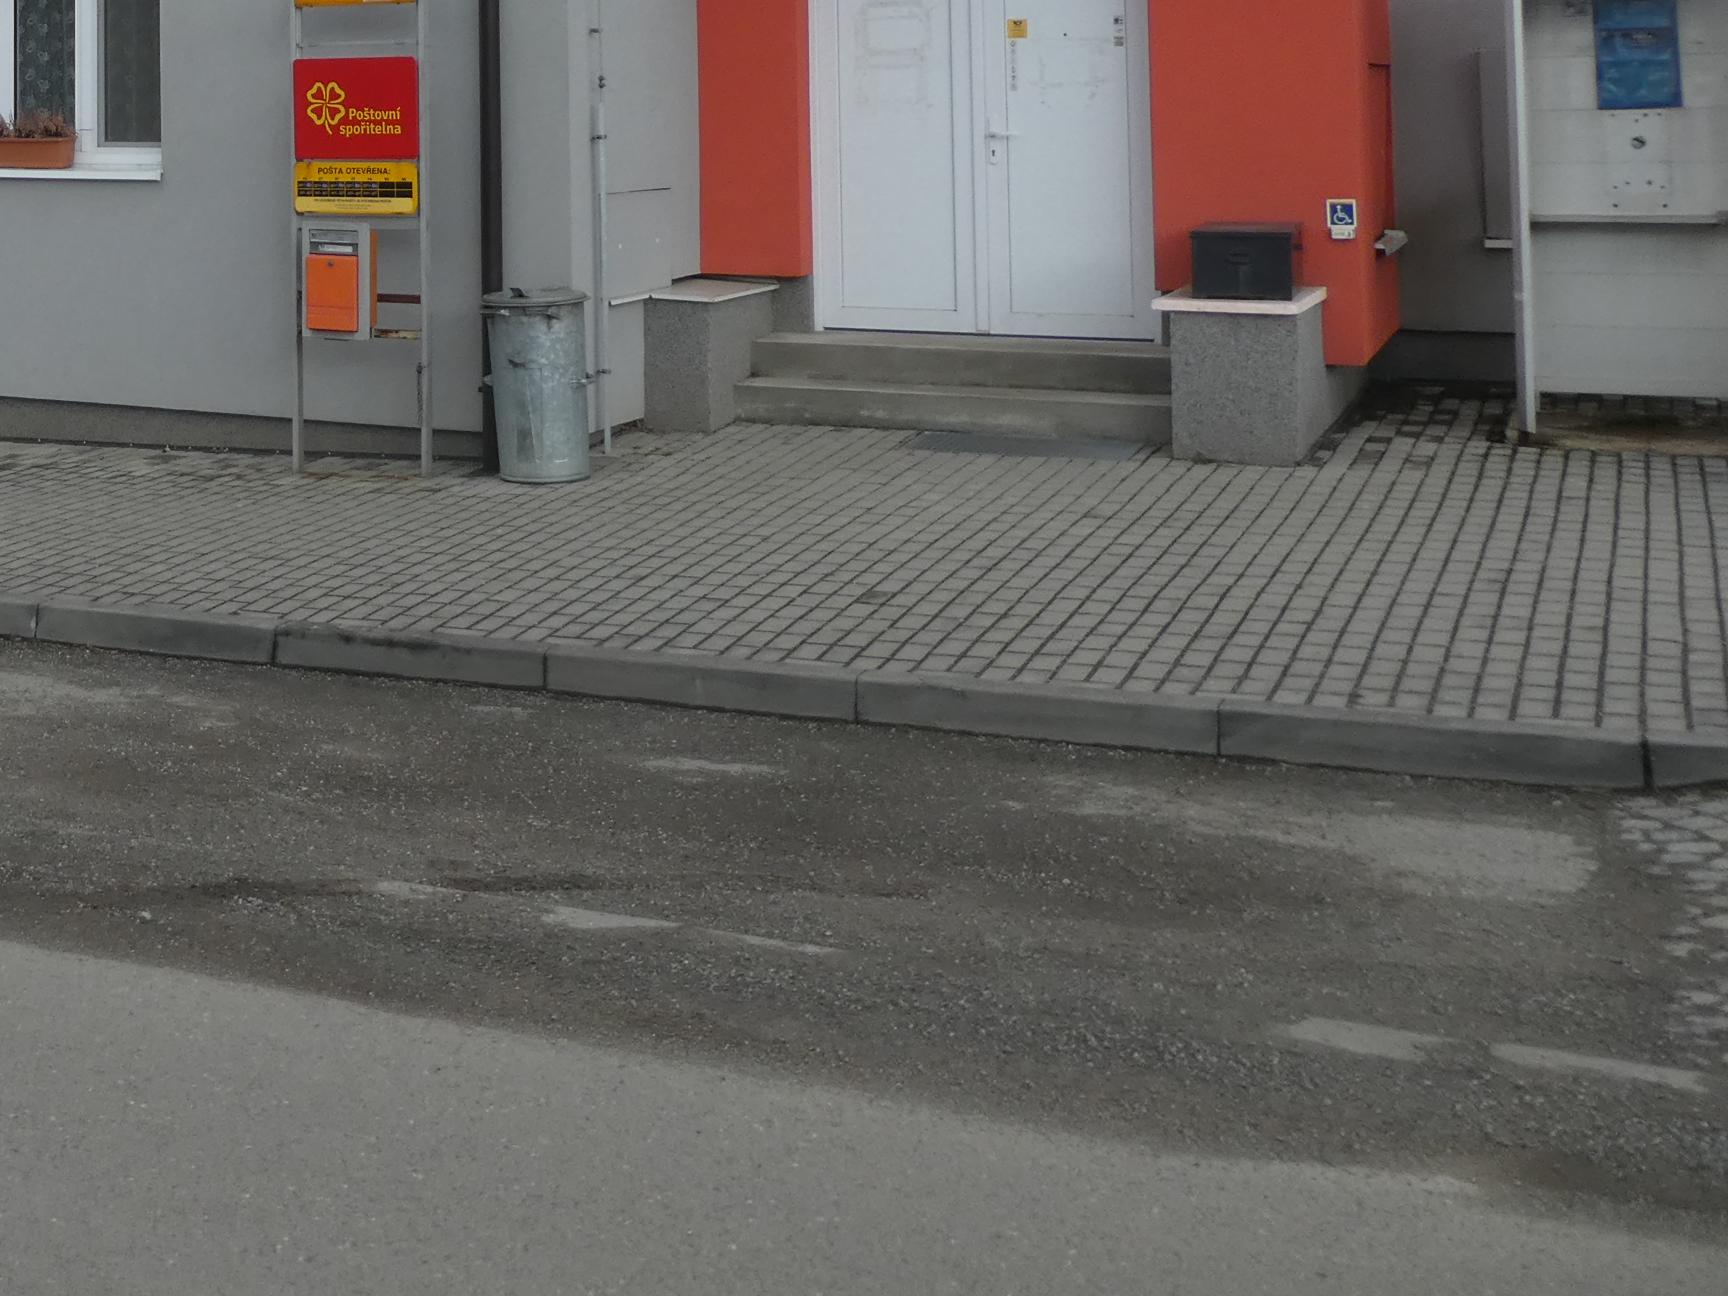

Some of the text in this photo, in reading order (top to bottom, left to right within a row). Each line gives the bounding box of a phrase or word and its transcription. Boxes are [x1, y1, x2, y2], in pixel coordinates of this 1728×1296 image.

[348, 107, 400, 120] Poštovní
[339, 122, 402, 138] spořitelna
[317, 165, 391, 175] POŠTA OTEVŘENA:
